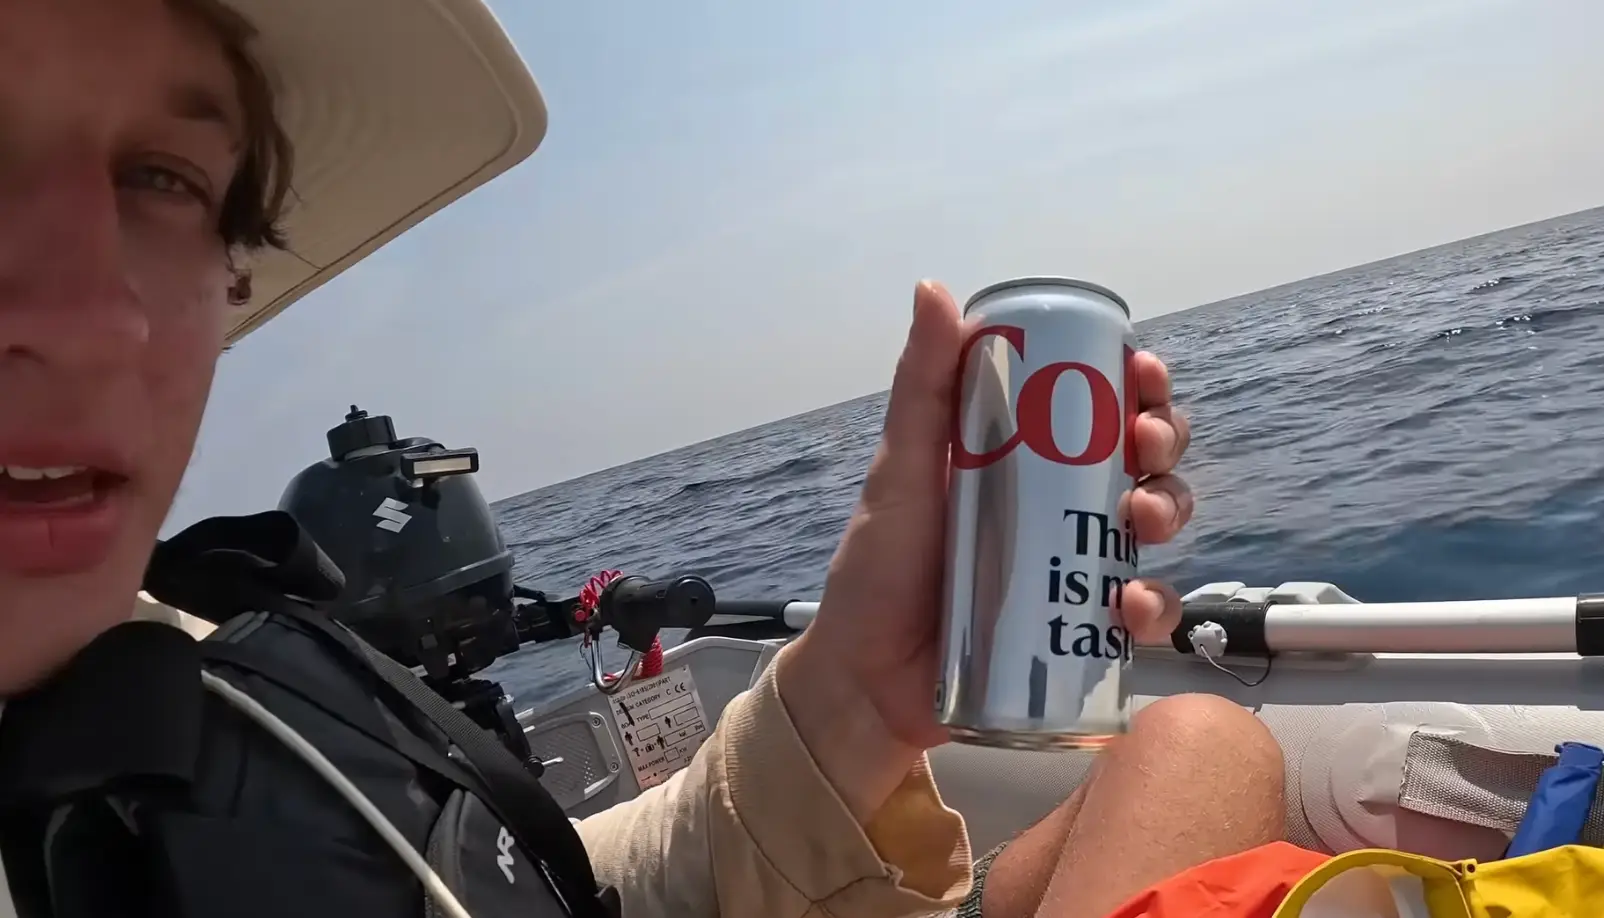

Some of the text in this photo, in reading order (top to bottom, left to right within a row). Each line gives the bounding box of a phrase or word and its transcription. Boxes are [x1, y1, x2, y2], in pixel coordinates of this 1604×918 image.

[1048, 556, 1131, 610] is m
[1048, 615, 1135, 661] tast
[635, 693, 661, 708] CATEGORY
[674, 682, 686, 693] CE
[636, 713, 650, 722] TYPE
[648, 757, 665, 768] POWER
